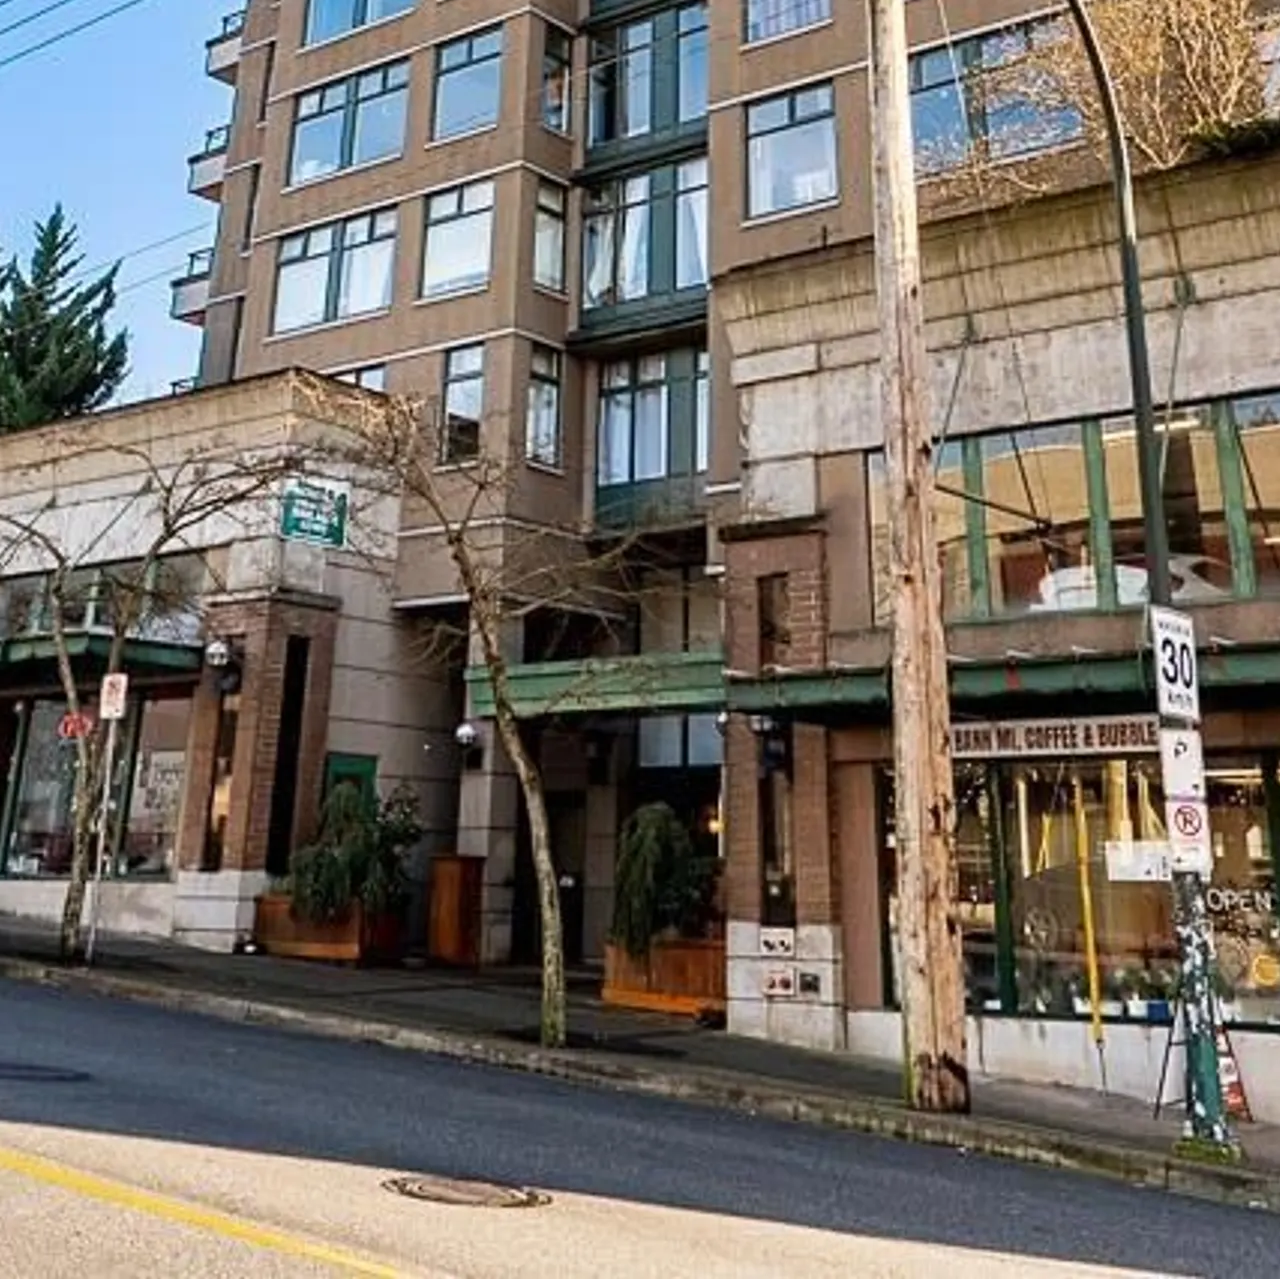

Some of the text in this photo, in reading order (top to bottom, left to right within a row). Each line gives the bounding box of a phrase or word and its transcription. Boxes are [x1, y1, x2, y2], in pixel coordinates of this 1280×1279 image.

[1162, 637, 1193, 689] 30
[954, 728, 992, 752] BANH
[1025, 724, 1078, 749] COFFEE
[1084, 724, 1094, 748] &
[1097, 721, 1157, 747] BUBBLE
[1206, 887, 1273, 912] OPEN
